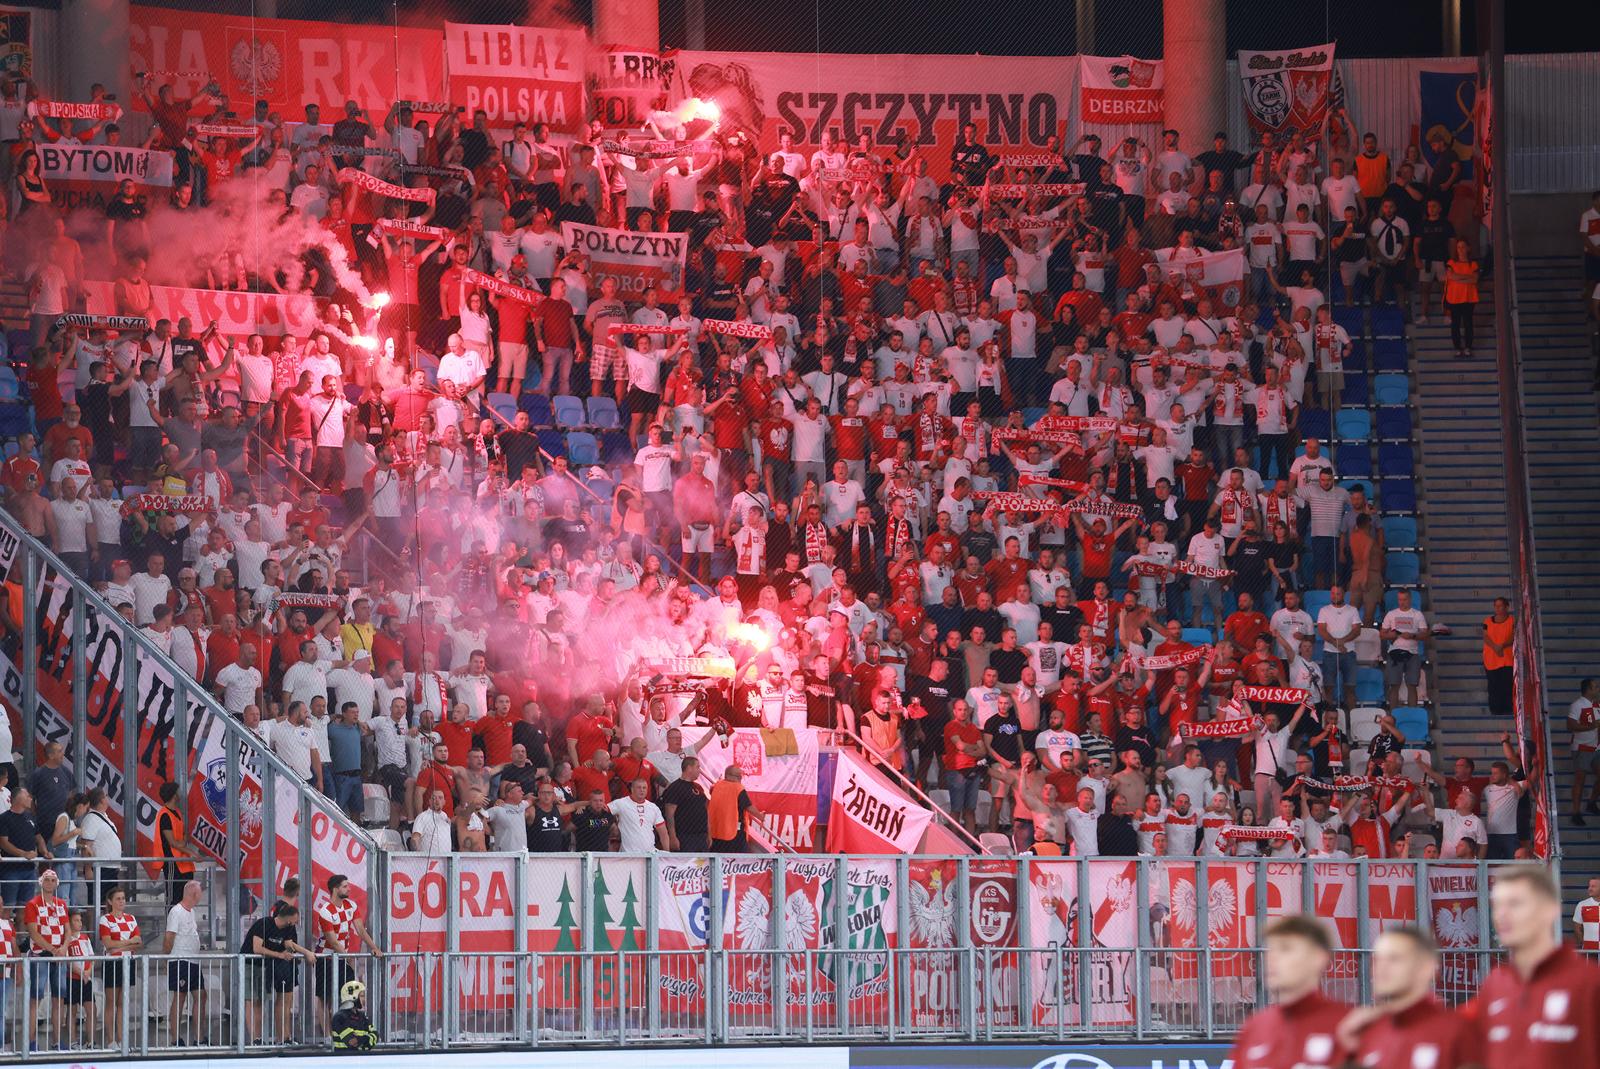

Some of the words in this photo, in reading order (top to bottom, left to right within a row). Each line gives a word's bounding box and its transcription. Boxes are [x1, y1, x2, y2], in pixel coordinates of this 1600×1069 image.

[56, 103, 99, 118] POLSKA
[410, 101, 450, 113] OLSKA
[466, 86, 567, 125] POLSKA
[776, 91, 1058, 147] SZCZYTNO
[43, 149, 134, 175] BYTOM
[571, 228, 682, 258] POŁCZYN
[480, 275, 533, 303] POLSKA
[1000, 498, 1058, 512] POLSKA
[1248, 687, 1304, 701] POLSKA
[1193, 720, 1250, 737] POLSKA
[842, 773, 906, 842] ŻAGAŃ
[391, 861, 513, 919] GÓRA
[675, 877, 729, 895] ZABRE
[984, 887, 997, 897] KS
[822, 904, 883, 946] WŁOKA
